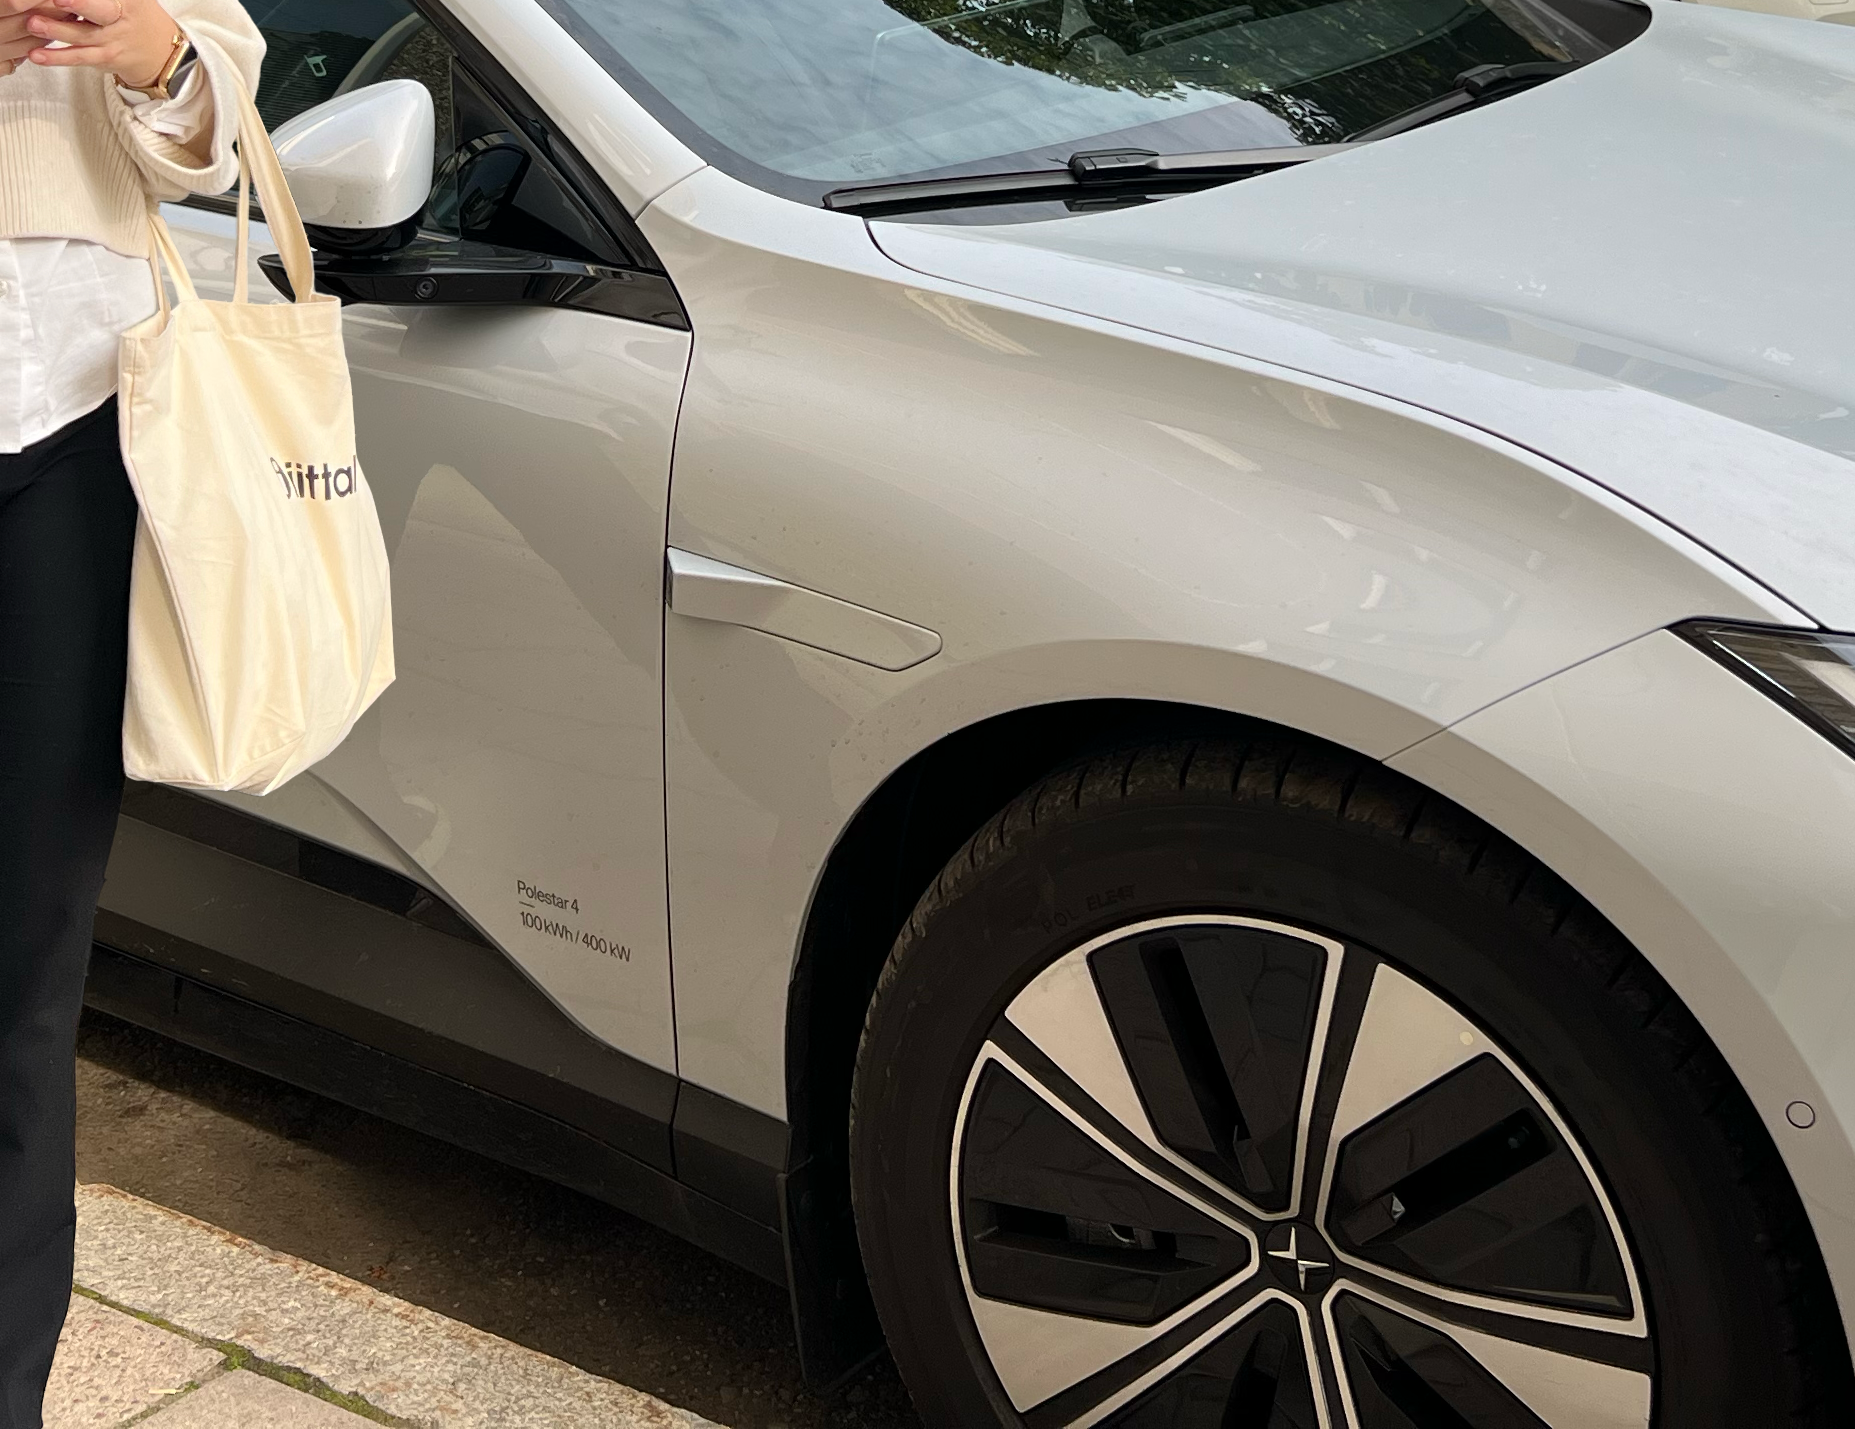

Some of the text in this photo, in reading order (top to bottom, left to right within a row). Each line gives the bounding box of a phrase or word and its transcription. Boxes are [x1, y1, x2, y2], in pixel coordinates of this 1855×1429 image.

[517, 879, 579, 914] Polestar 4
[520, 911, 542, 931] 100
[544, 919, 573, 942] kWh
[582, 932, 607, 954] 400
[609, 941, 631, 962] kW
